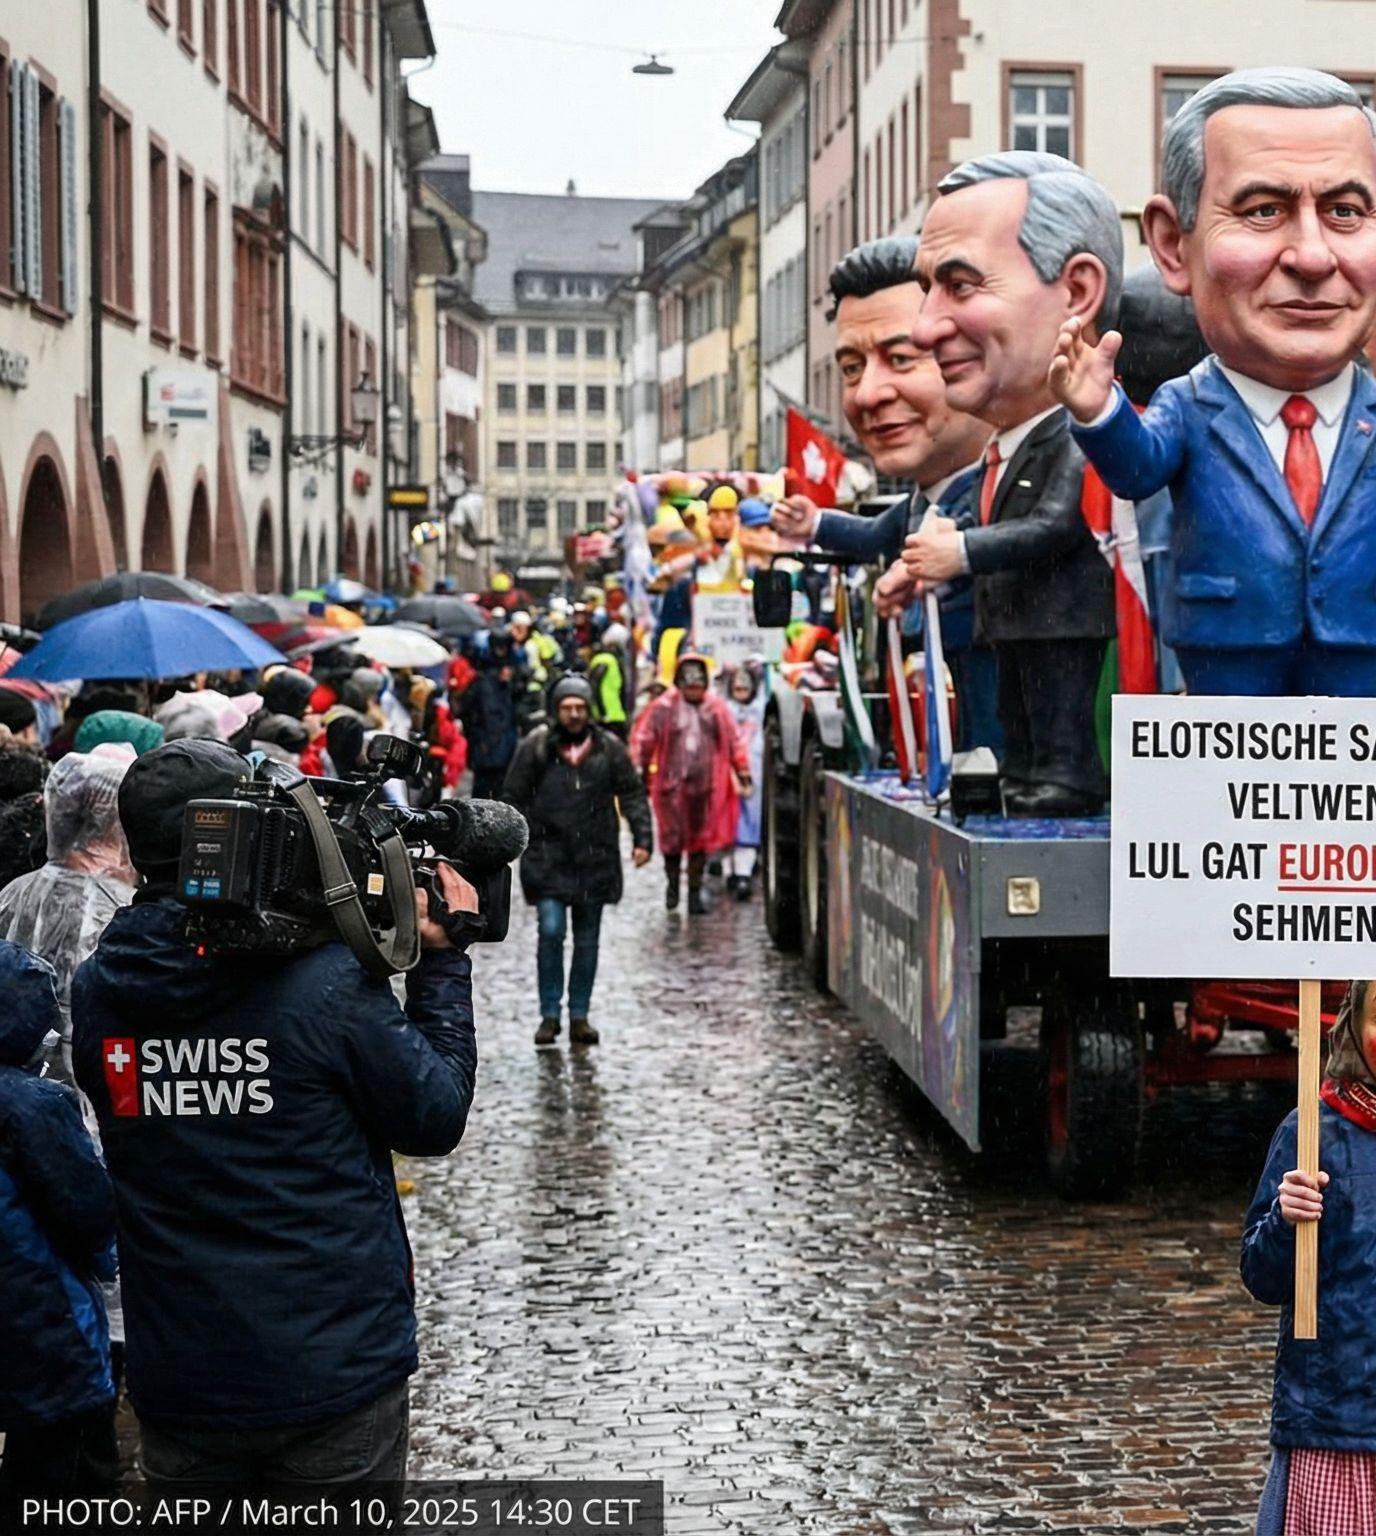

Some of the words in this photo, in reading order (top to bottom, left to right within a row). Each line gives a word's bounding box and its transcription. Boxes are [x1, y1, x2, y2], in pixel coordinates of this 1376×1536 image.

[1132, 721, 1337, 761] ELOTSISCHE
[1129, 842, 1190, 880] LUL
[1202, 842, 1268, 880] GAT
[141, 1038, 270, 1074] SWISS
[143, 1079, 274, 1116] NEWS
